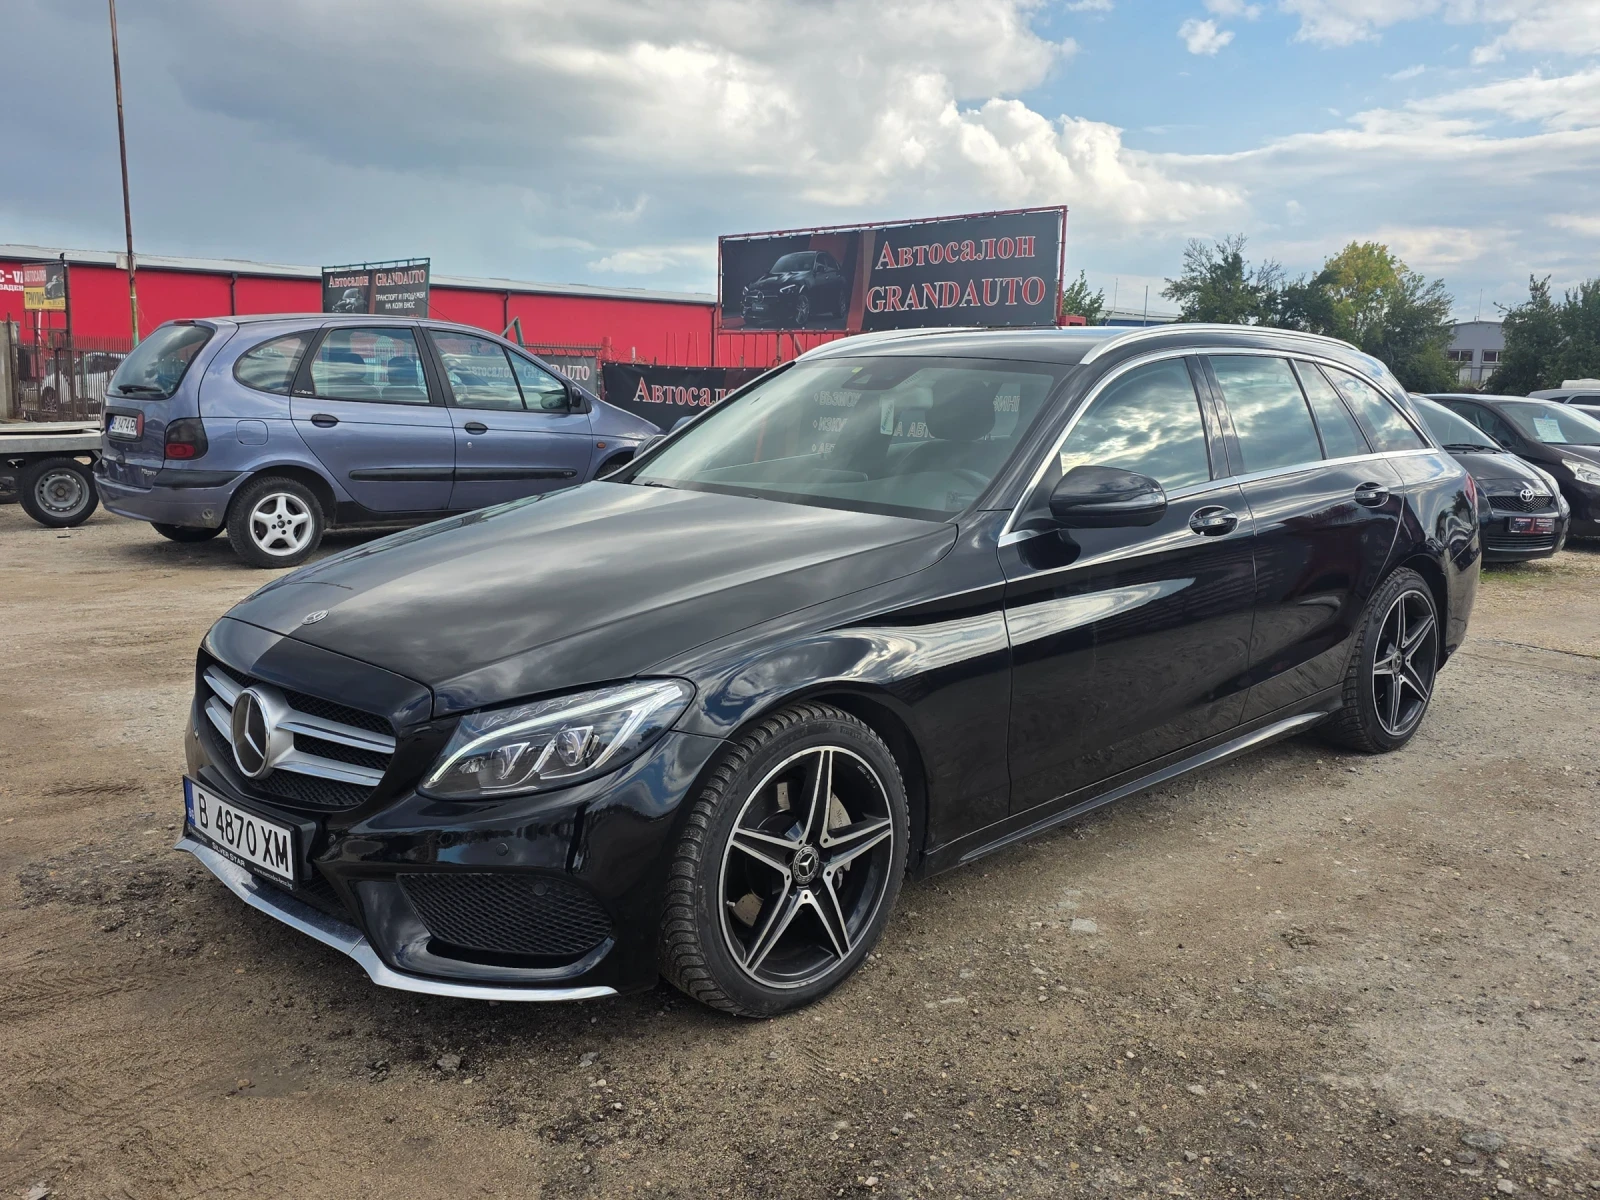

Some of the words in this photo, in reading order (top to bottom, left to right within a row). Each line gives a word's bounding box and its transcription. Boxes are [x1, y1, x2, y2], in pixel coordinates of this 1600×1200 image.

[875, 236, 1036, 270] Автосалон
[328, 275, 369, 288] Автосалон
[375, 269, 426, 287] GRANDAUTO
[375, 293, 398, 301] ТРАНСПОРТ
[402, 291, 426, 301] ПРОДАЖБИ
[403, 301, 415, 309] ВНОС
[866, 276, 1046, 313] GRANDAUTO
[633, 376, 736, 407] Автосал
[198, 793, 209, 829] B
[216, 805, 257, 857] 4870
[261, 825, 289, 873] XM
[211, 842, 230, 859] SILVER
[229, 852, 246, 868] STAR
